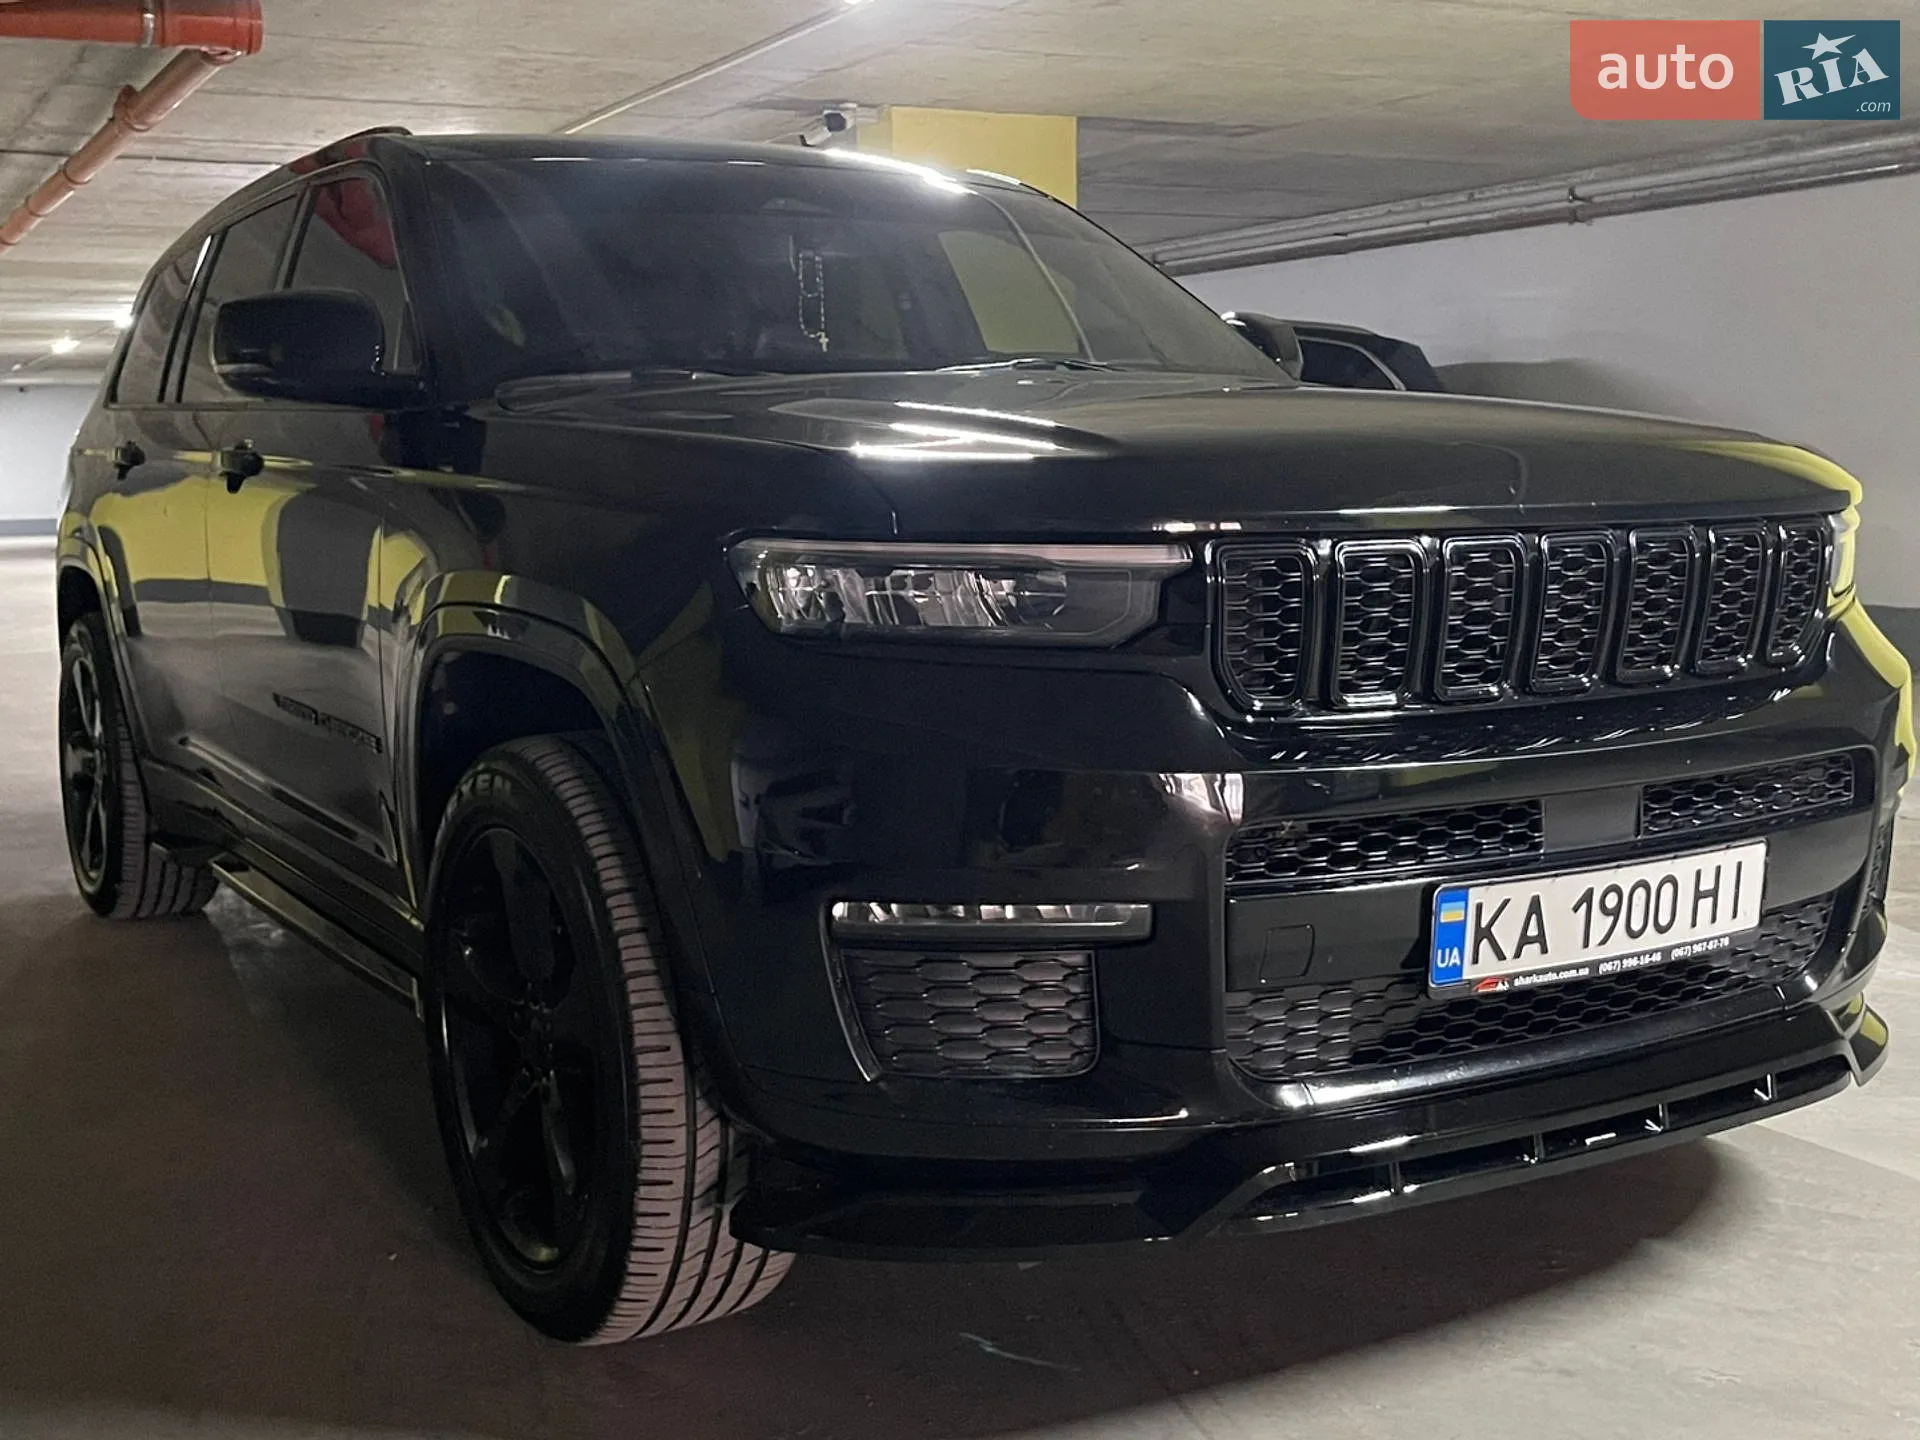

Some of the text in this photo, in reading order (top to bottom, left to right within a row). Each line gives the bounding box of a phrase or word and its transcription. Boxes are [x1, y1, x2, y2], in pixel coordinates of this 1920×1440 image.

[1471, 860, 1743, 966] KA 1900 HI
[1436, 946, 1461, 969] UA
